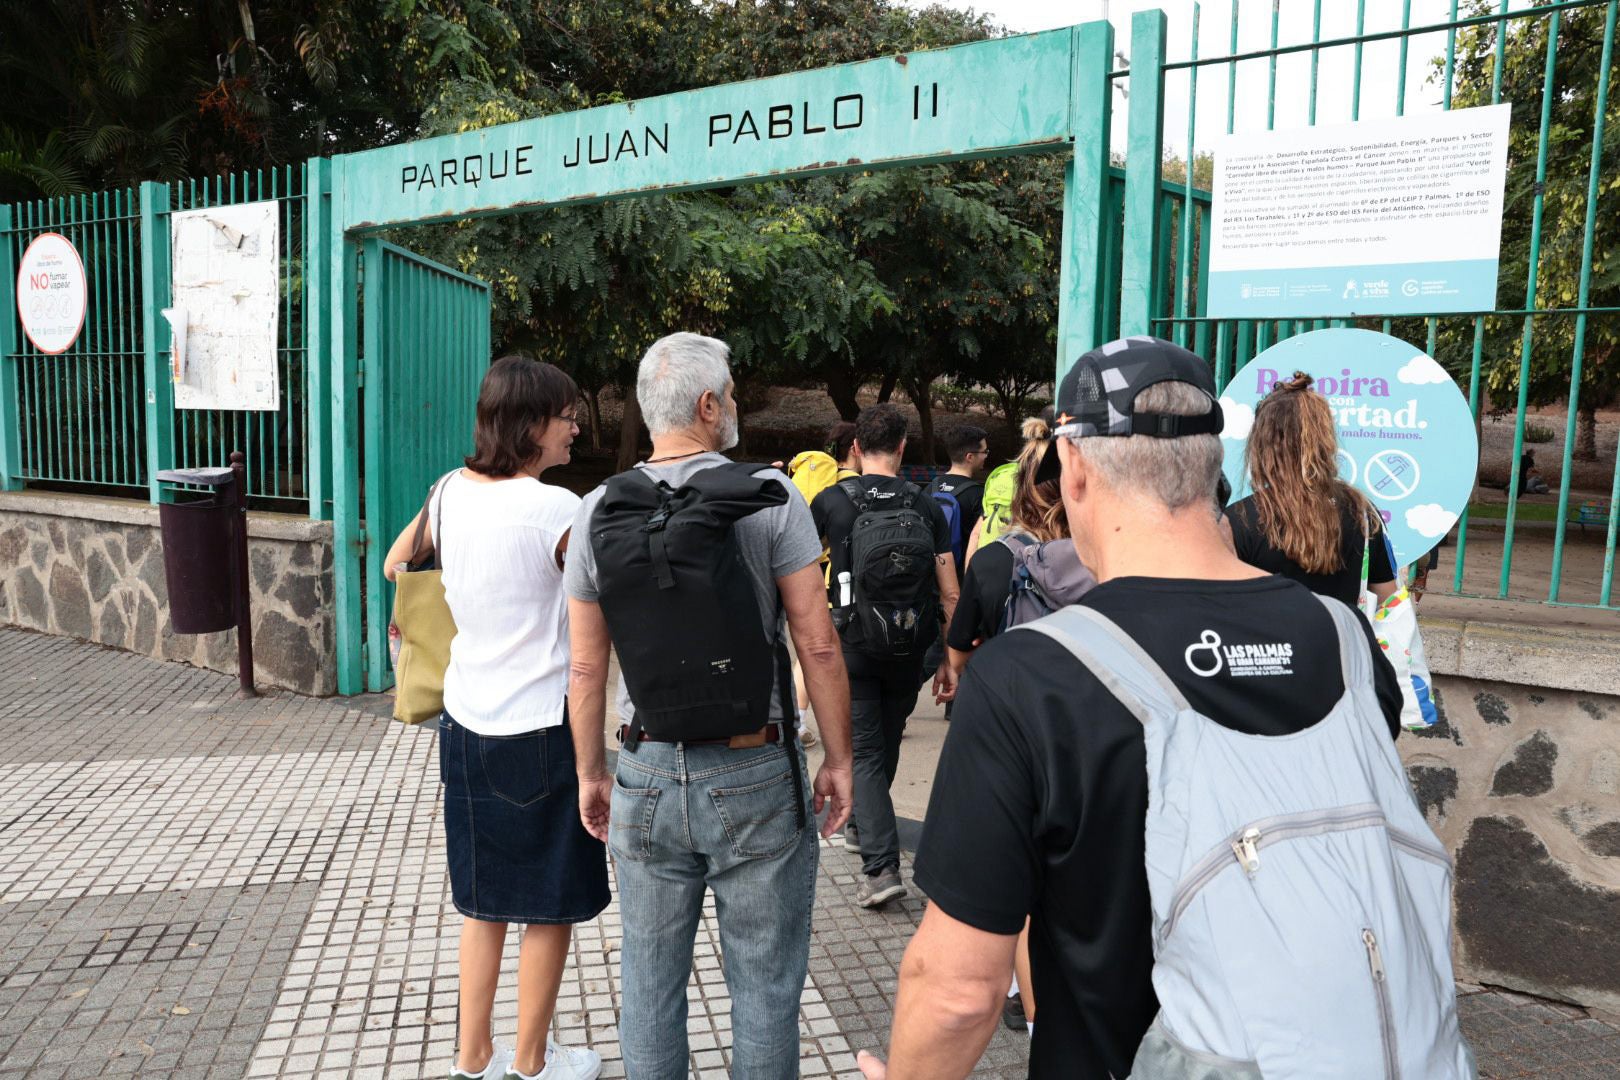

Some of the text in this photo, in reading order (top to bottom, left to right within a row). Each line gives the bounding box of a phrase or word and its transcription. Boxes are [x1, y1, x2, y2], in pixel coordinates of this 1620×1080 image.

[402, 82, 939, 194] PARQUE JUAN PABLO II
[1430, 136, 1459, 144] Parques
[1266, 159, 1299, 167] Asociación
[1301, 157, 1328, 165] Española
[1355, 160, 1378, 168] Parque
[30, 272, 68, 290] NO fumar
[50, 281, 71, 290] vapear
[1256, 368, 1391, 397] Rpira
[1328, 397, 1355, 406] con
[1341, 429, 1423, 440] malos humos.
[1223, 643, 1293, 658] LAS PALMAS
[1227, 658, 1237, 666] DE
